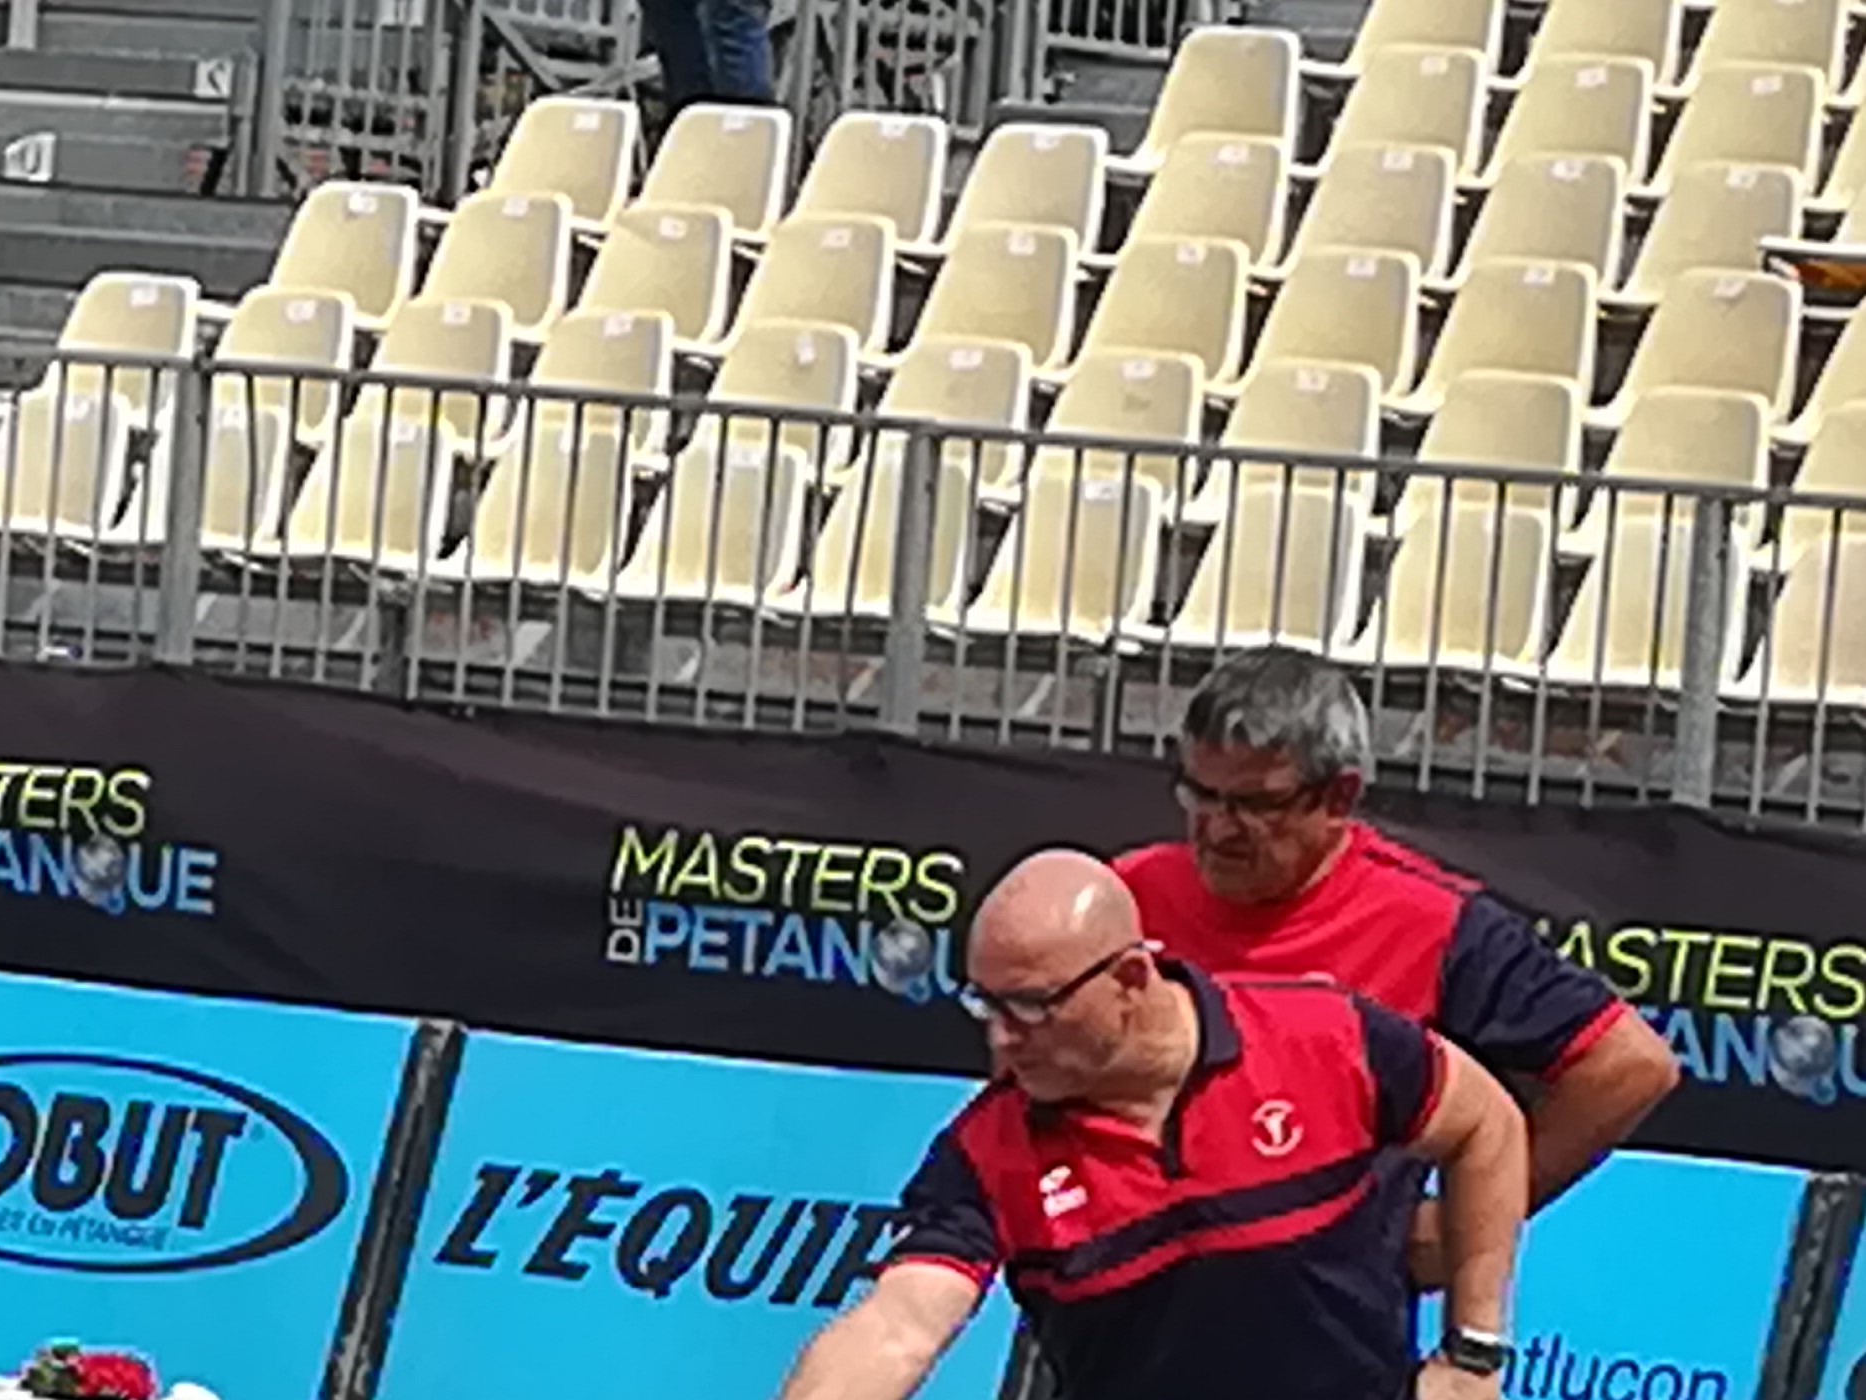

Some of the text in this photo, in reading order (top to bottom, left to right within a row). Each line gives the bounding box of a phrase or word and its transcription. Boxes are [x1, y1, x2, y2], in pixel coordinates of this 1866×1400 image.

[611, 826, 964, 923] MASTERS
[607, 898, 643, 964] DE
[1536, 918, 1866, 1019] ASTERS
[434, 1163, 901, 1308] L'ÉQUIP
